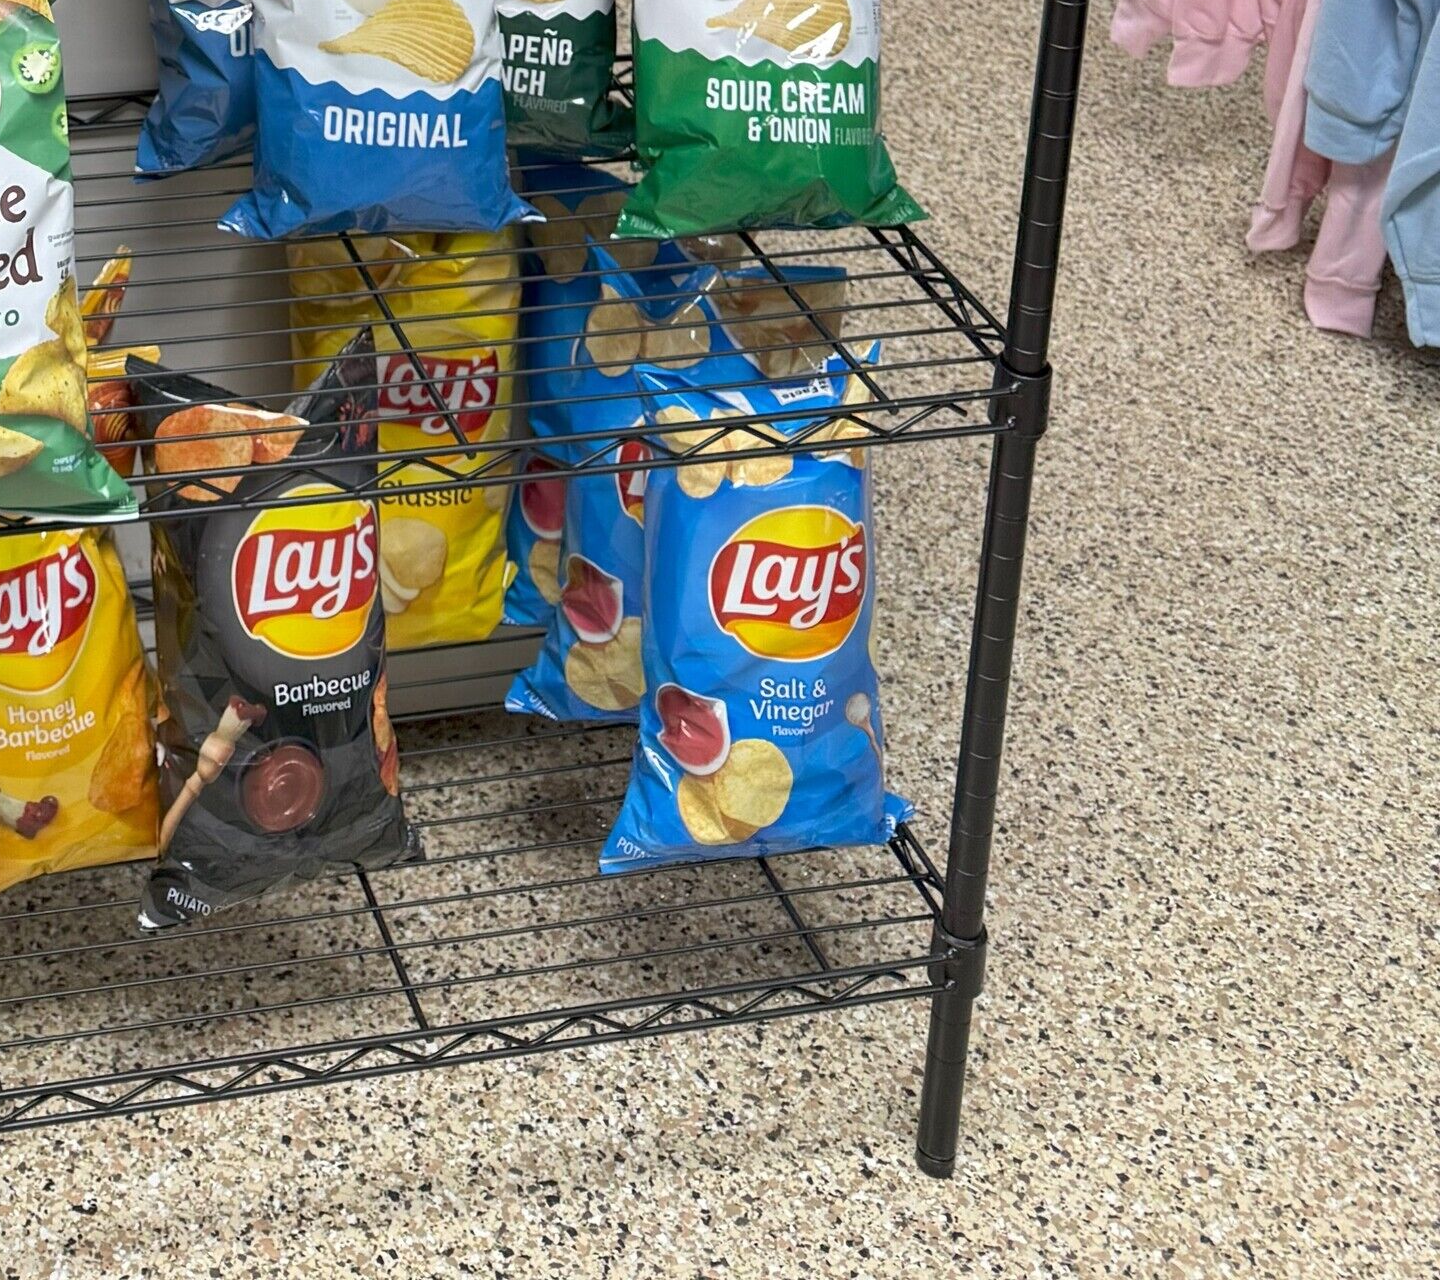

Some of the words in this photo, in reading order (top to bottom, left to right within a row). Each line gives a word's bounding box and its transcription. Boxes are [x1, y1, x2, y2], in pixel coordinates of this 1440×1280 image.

[513, 95, 568, 114] FLAVORED
[706, 78, 771, 112] SOUR
[781, 80, 866, 114] CREAM
[324, 106, 469, 148] ORIGINAL
[747, 117, 762, 143] &
[770, 117, 831, 145] ONION
[379, 480, 474, 505] Classic
[247, 510, 376, 620] Lay's
[722, 538, 861, 630] Lay's
[274, 669, 372, 707] Barbecue
[760, 677, 808, 700] Salt
[811, 678, 827, 698] &
[6, 697, 77, 725] Honey
[302, 697, 352, 717] Flavored
[749, 696, 834, 727] Vinegar
[772, 725, 815, 737] Flavored
[25, 744, 71, 762] Flavored
[166, 886, 211, 916] POTATO
